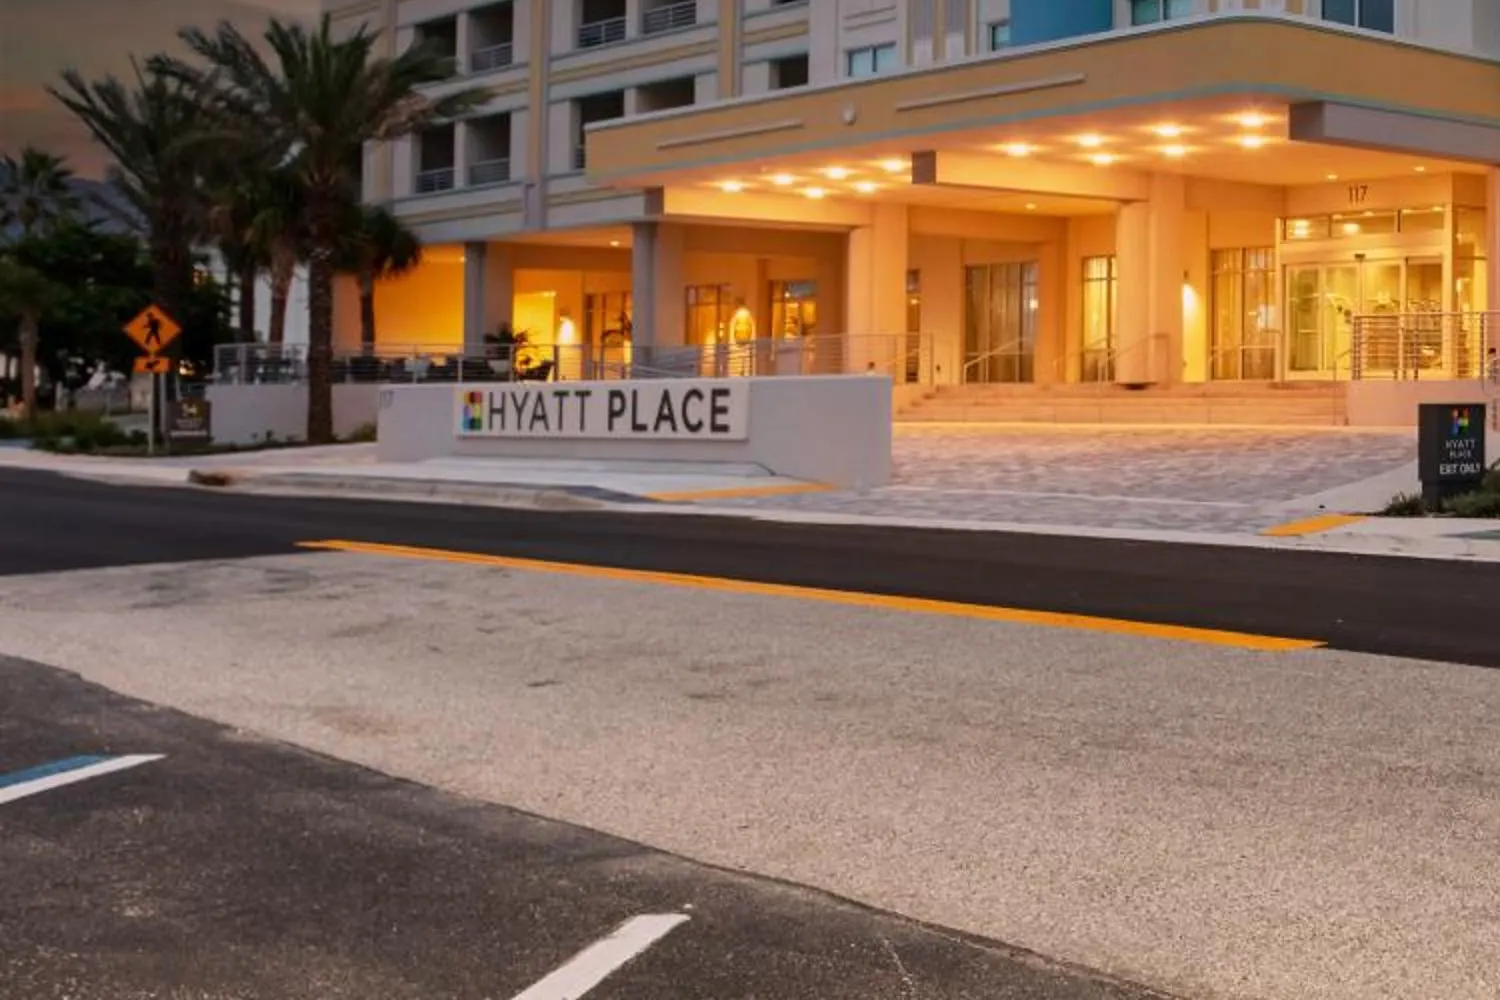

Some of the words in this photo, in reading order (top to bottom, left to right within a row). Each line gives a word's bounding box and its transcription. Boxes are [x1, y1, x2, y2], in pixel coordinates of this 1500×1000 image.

[1348, 184, 1368, 204] 117
[488, 390, 592, 431] HYATT
[606, 387, 731, 433] PLACE
